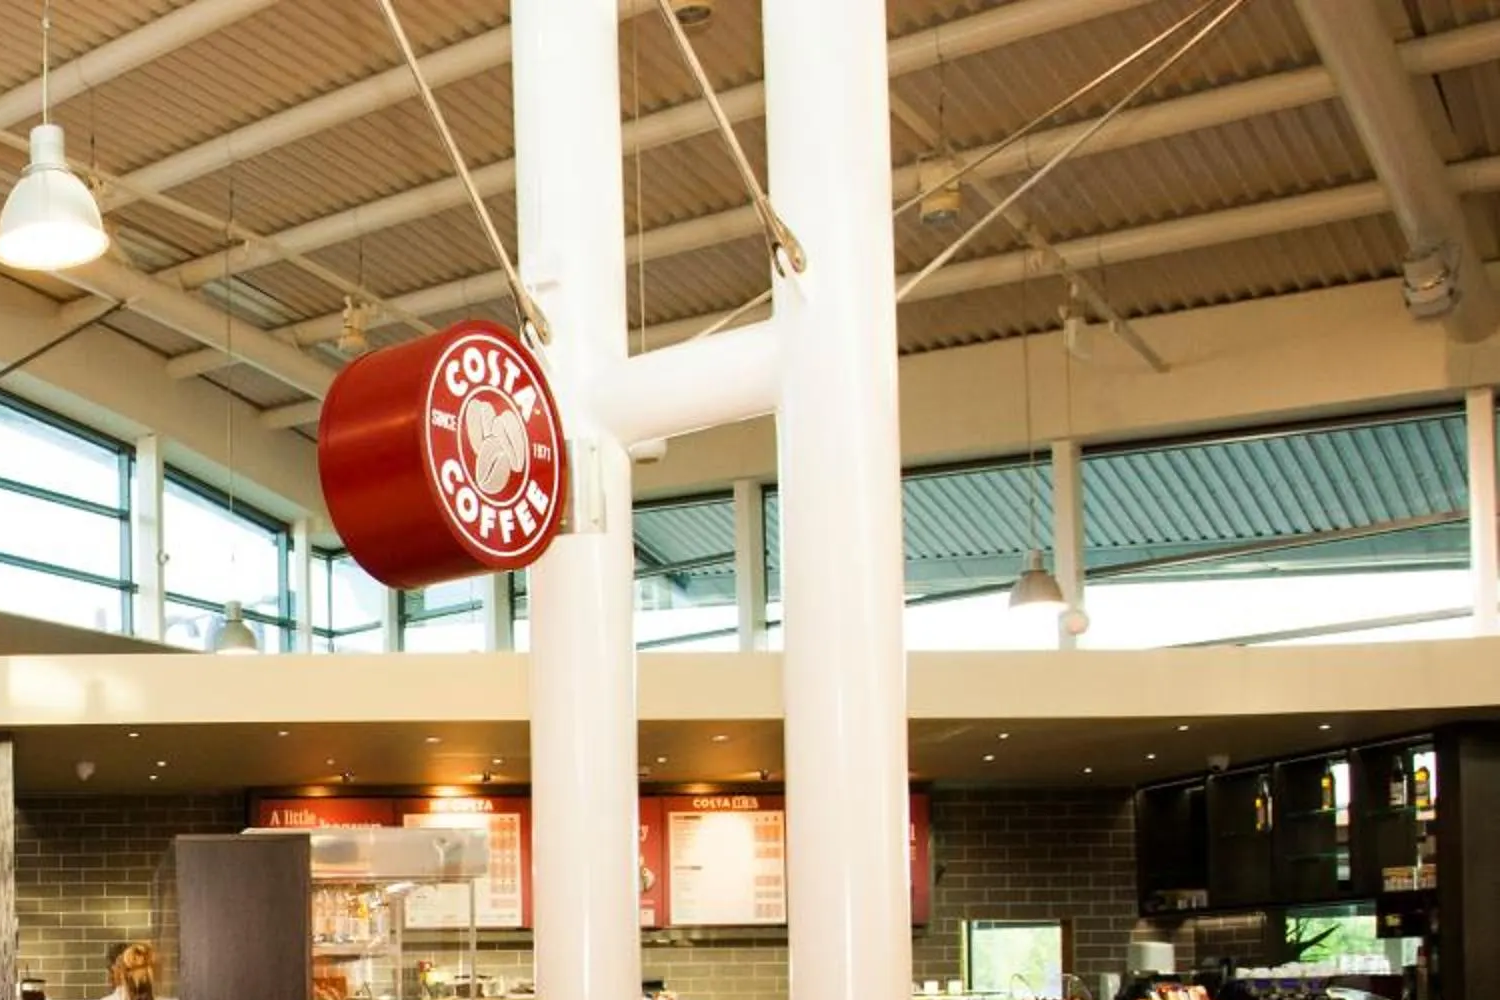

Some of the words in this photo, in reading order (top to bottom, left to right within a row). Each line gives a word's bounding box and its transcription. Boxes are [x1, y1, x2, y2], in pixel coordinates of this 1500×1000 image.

[431, 409, 457, 431] SINCE
[445, 347, 537, 424] COSTA
[441, 459, 549, 544] COFFEE
